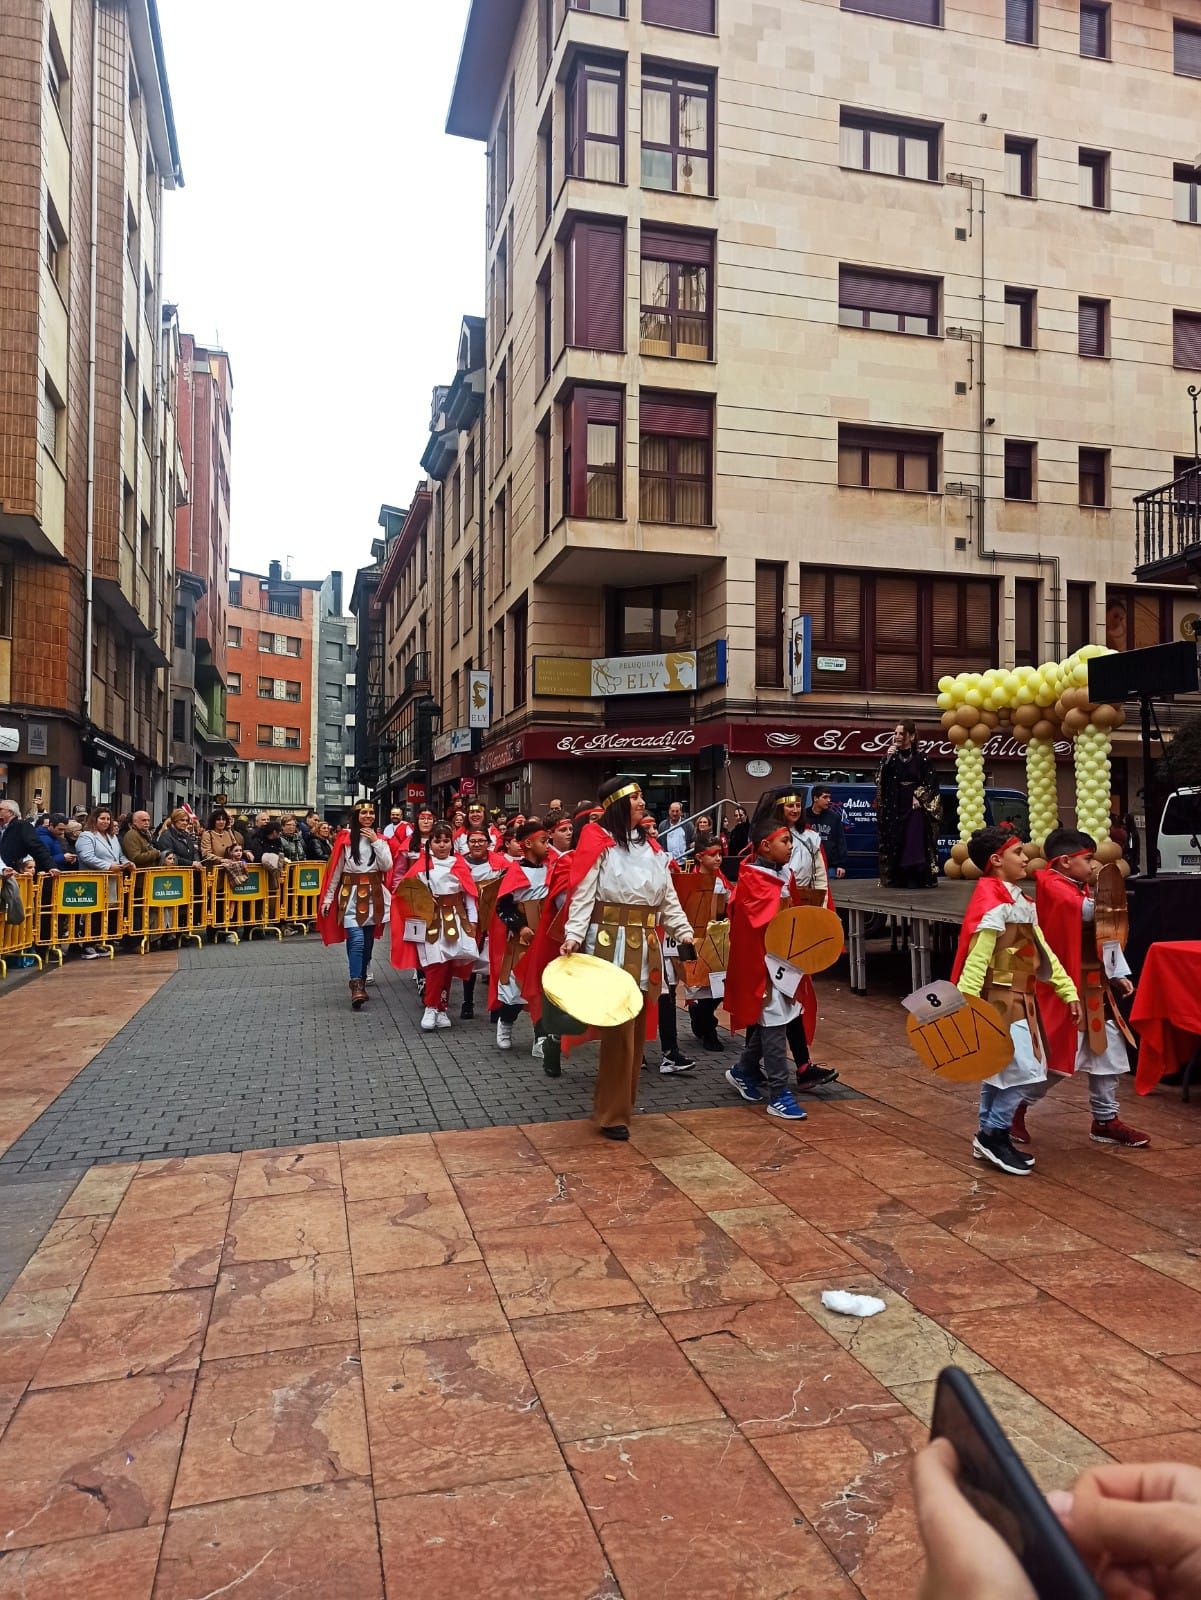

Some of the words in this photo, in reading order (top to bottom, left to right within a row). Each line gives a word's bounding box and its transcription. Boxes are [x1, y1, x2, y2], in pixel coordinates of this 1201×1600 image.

[627, 672, 660, 690] ELY
[471, 714, 488, 722] ELY
[556, 735, 584, 751] El
[584, 730, 695, 749] Mercadillo
[814, 729, 861, 751] El
[843, 798, 871, 809] Astur
[412, 925, 418, 936] 1
[665, 937, 677, 949] 16
[775, 966, 786, 981] 5
[925, 992, 942, 1008] 8
